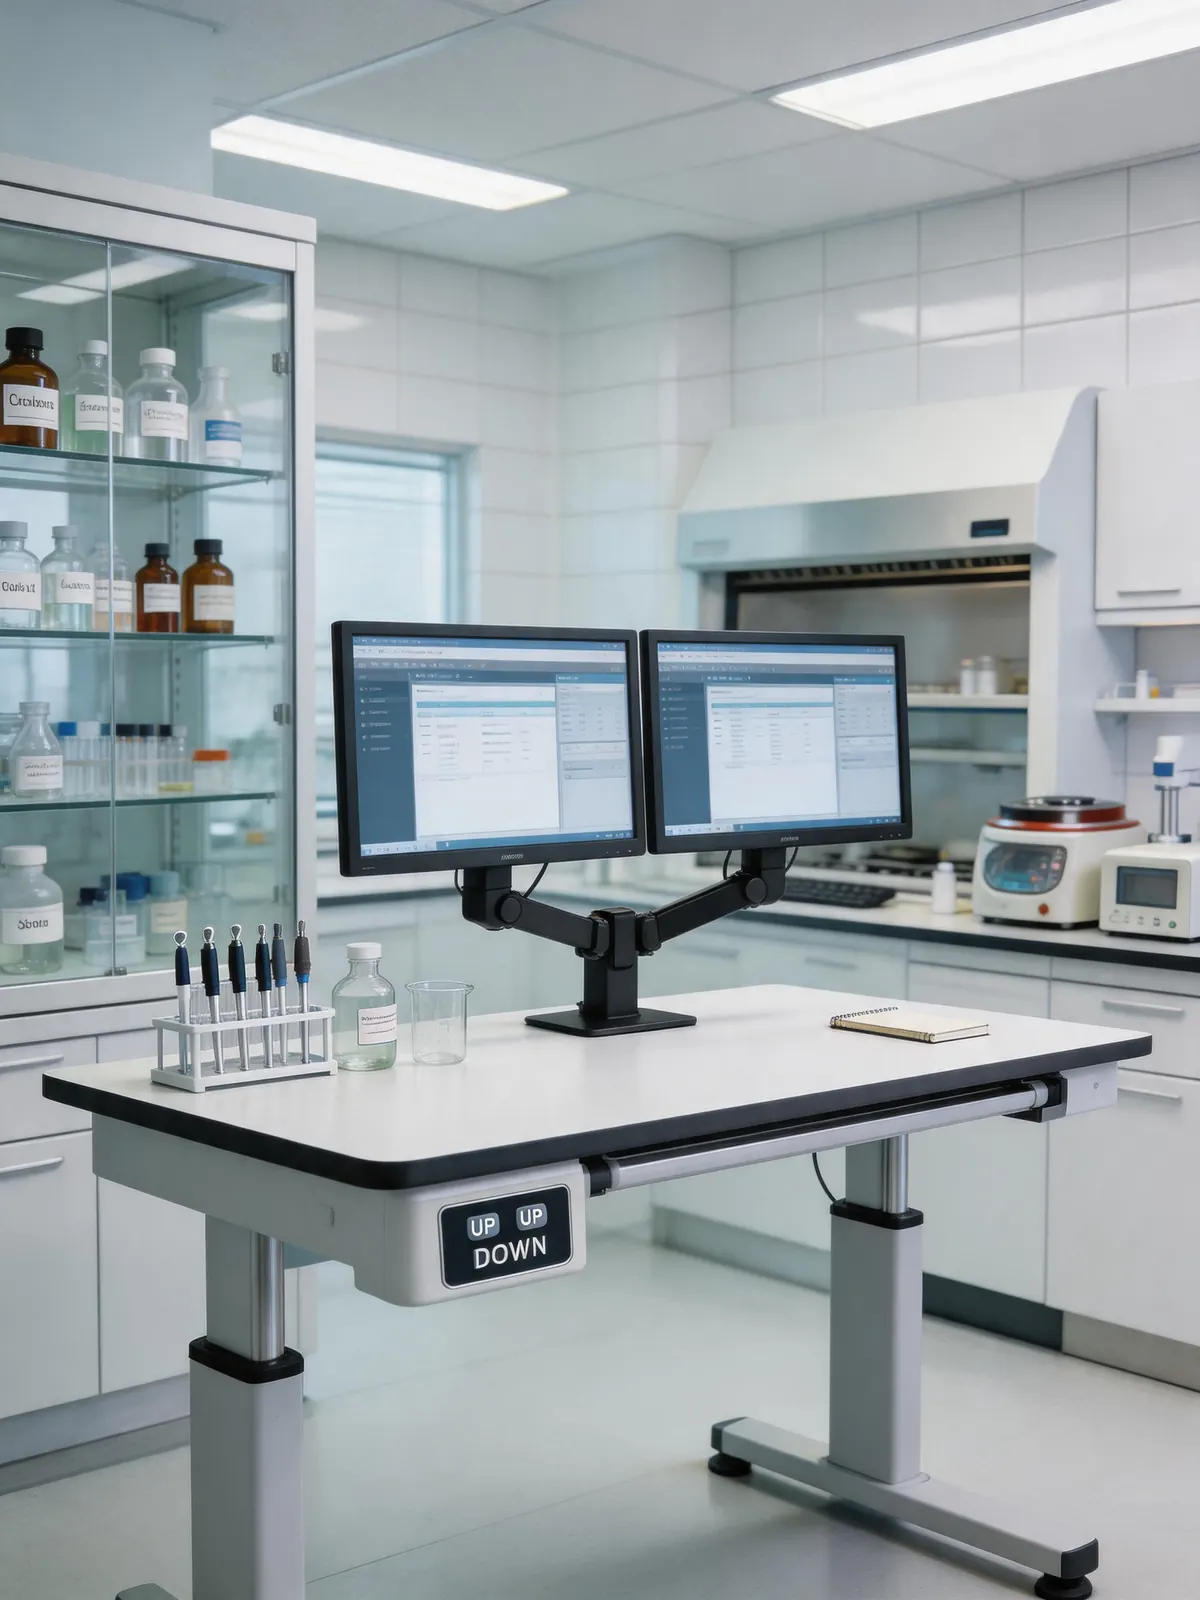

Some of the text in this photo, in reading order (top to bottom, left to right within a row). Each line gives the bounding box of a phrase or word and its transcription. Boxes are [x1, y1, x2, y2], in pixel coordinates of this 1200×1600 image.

[471, 1208, 543, 1237] UP UP
[473, 1235, 546, 1269] DOWN
